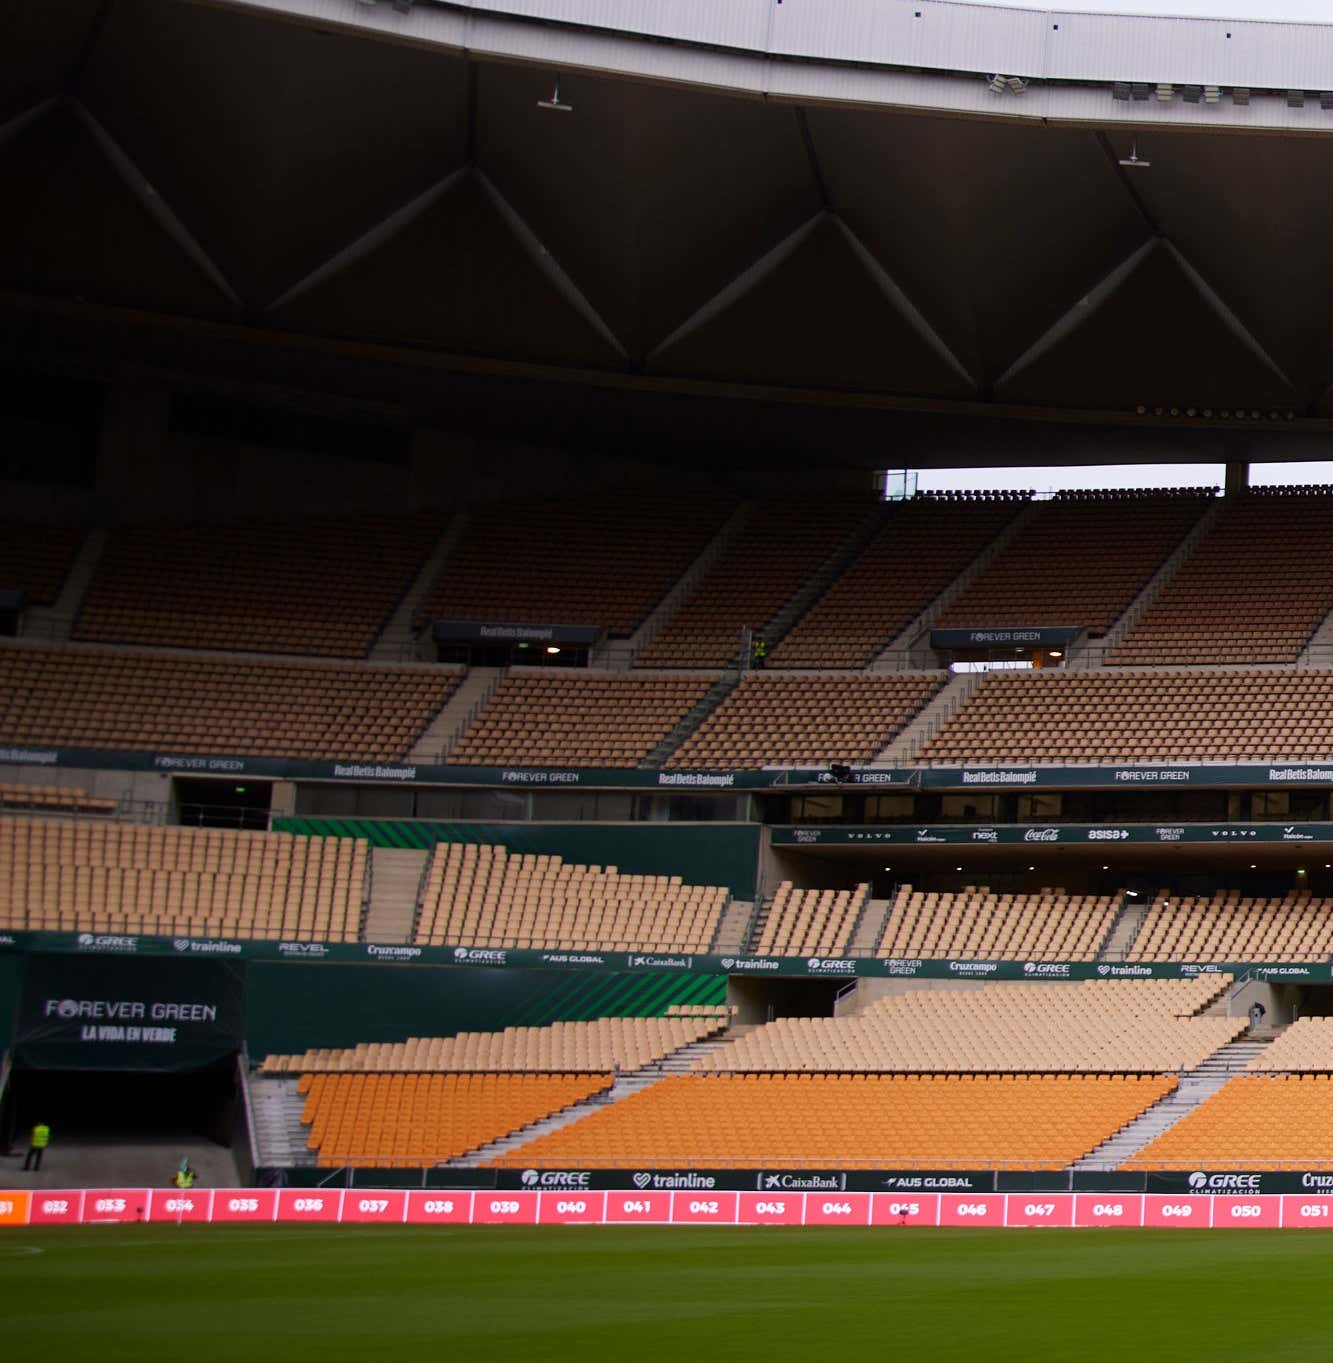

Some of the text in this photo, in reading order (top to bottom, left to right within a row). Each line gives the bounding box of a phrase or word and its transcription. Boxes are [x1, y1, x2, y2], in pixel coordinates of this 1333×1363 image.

[970, 632, 1041, 641] FOREVER GREEN
[964, 772, 1036, 782] Real Betis Balompié
[1270, 770, 1286, 779] Real
[1287, 769, 1306, 779] Betis
[735, 959, 780, 969] trainline
[817, 960, 857, 968] GREE
[883, 959, 922, 967] FOREVER
[949, 962, 998, 971] Cruzcampo
[889, 966, 917, 974] GREEN
[45, 1000, 217, 1020] FOREVER GREEN
[81, 1025, 176, 1042] LA VIDA EN VERDE
[540, 1172, 591, 1184] GREE
[652, 1173, 716, 1187] trainline
[779, 1176, 839, 1188] CaixaBank
[896, 1178, 973, 1186] AUS GLOBAL
[1208, 1175, 1262, 1187] GREE
[293, 1199, 324, 1211] 036
[358, 1200, 389, 1212] 037
[424, 1201, 454, 1212] 038
[490, 1201, 520, 1213] 039
[556, 1202, 587, 1213] 040
[623, 1201, 651, 1212] 041
[689, 1202, 719, 1213] 042
[755, 1203, 786, 1213] 043
[822, 1203, 852, 1214] 044
[957, 1204, 987, 1215] 046
[1024, 1204, 1055, 1215] 047
[1093, 1205, 1123, 1215] 048
[1161, 1205, 1193, 1216] 049
[1300, 1205, 1329, 1216] 051
[1231, 1206, 1262, 1216] 050
